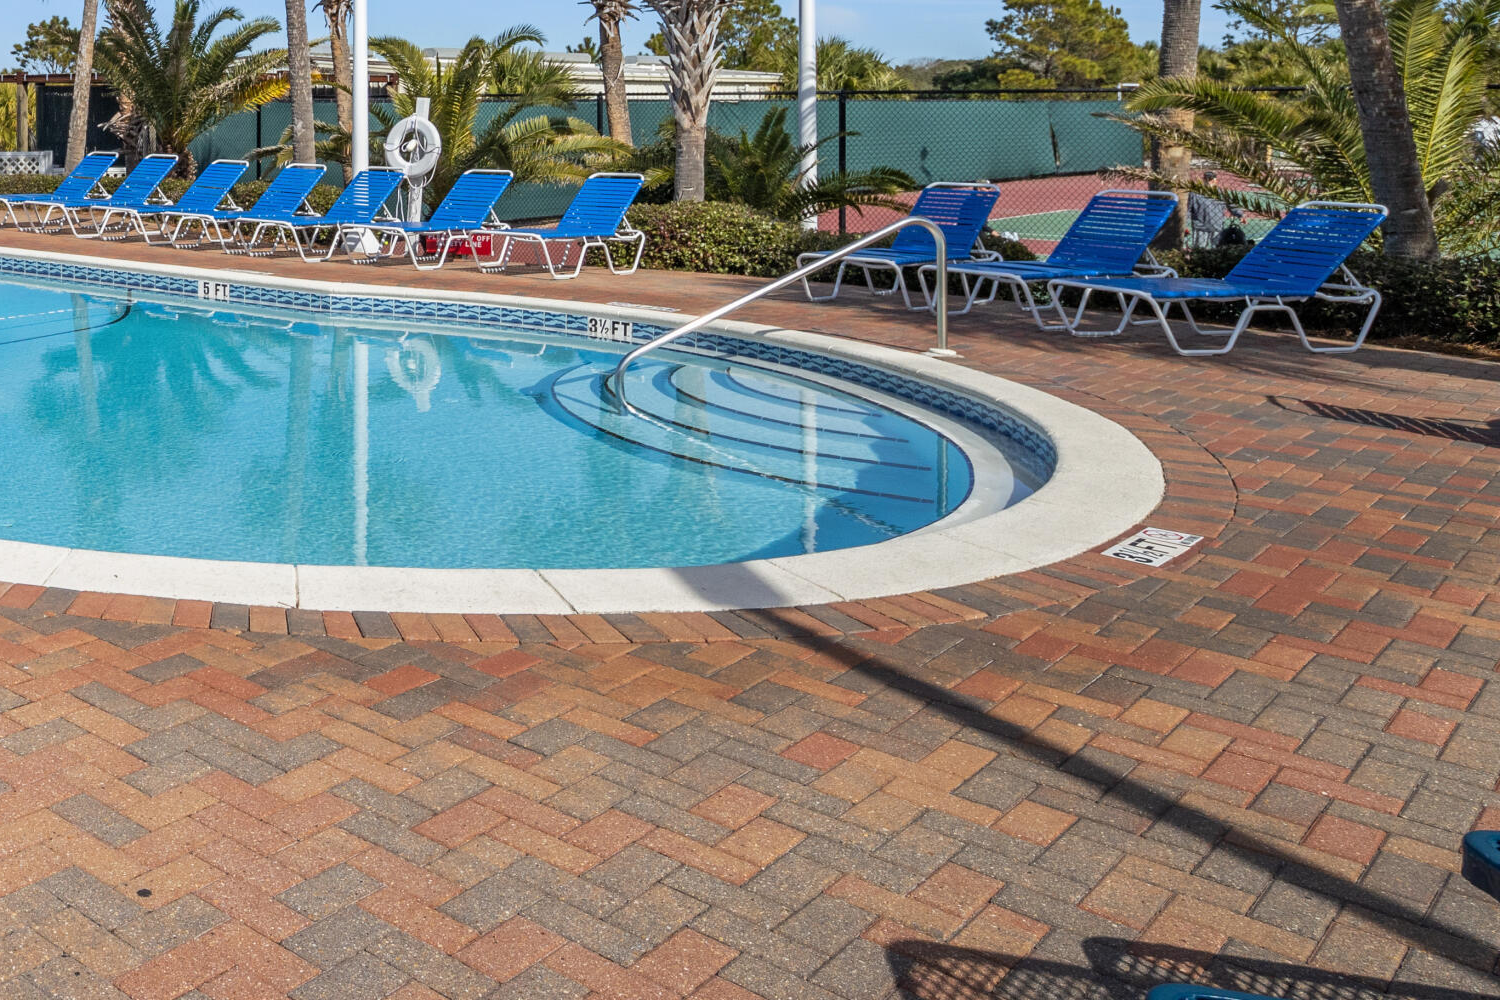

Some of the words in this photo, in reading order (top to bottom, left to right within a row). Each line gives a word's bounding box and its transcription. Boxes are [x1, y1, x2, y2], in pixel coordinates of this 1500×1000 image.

[203, 282, 210, 295] 5
[611, 321, 630, 337] FT
[1127, 537, 1178, 554] FT
